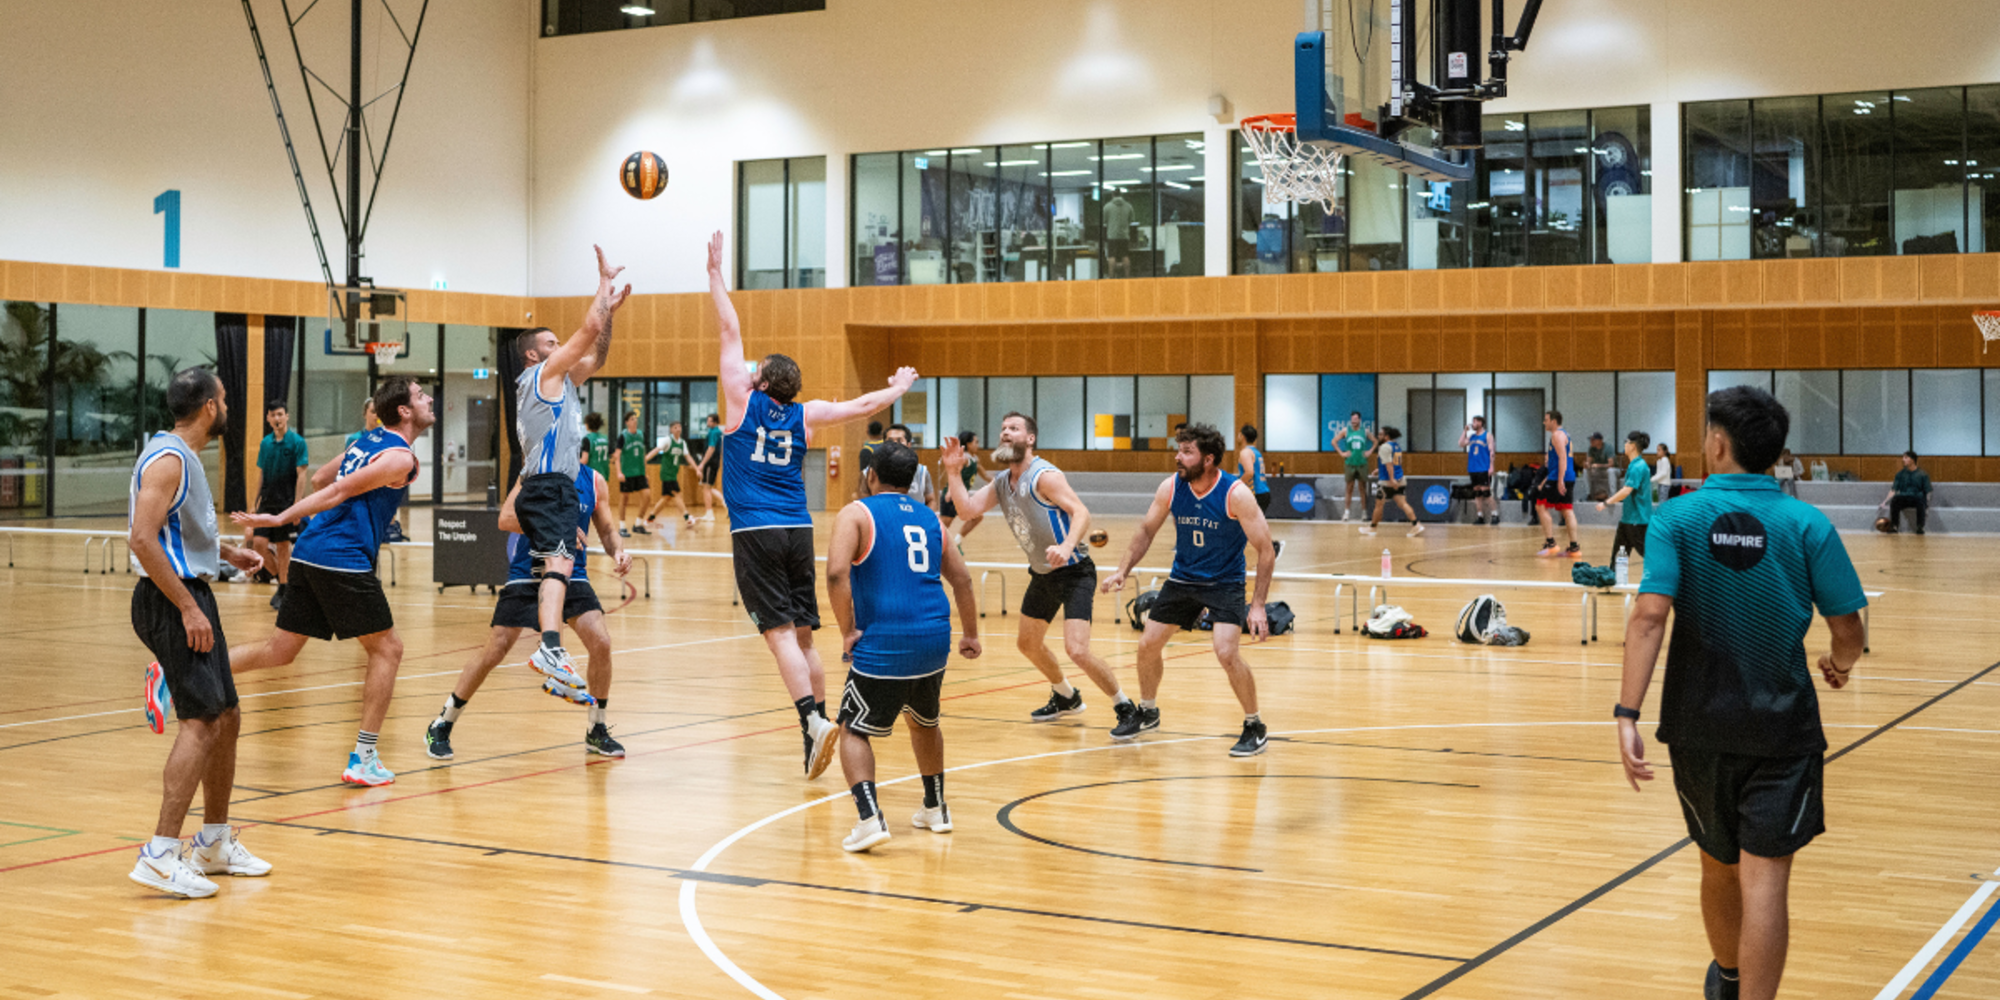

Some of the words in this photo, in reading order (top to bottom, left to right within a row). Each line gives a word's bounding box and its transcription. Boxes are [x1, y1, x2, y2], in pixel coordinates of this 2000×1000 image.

[153, 189, 181, 268] 1
[751, 425, 792, 466] 13
[1293, 493, 1312, 502] ARC
[1426, 495, 1447, 505] ARC
[438, 518, 466, 529] Respect
[438, 531, 451, 541] The
[452, 531, 477, 542] Umpire
[1193, 530, 1204, 547] 0
[1712, 533, 1763, 548] UMPIRE
[903, 525, 930, 573] 8
